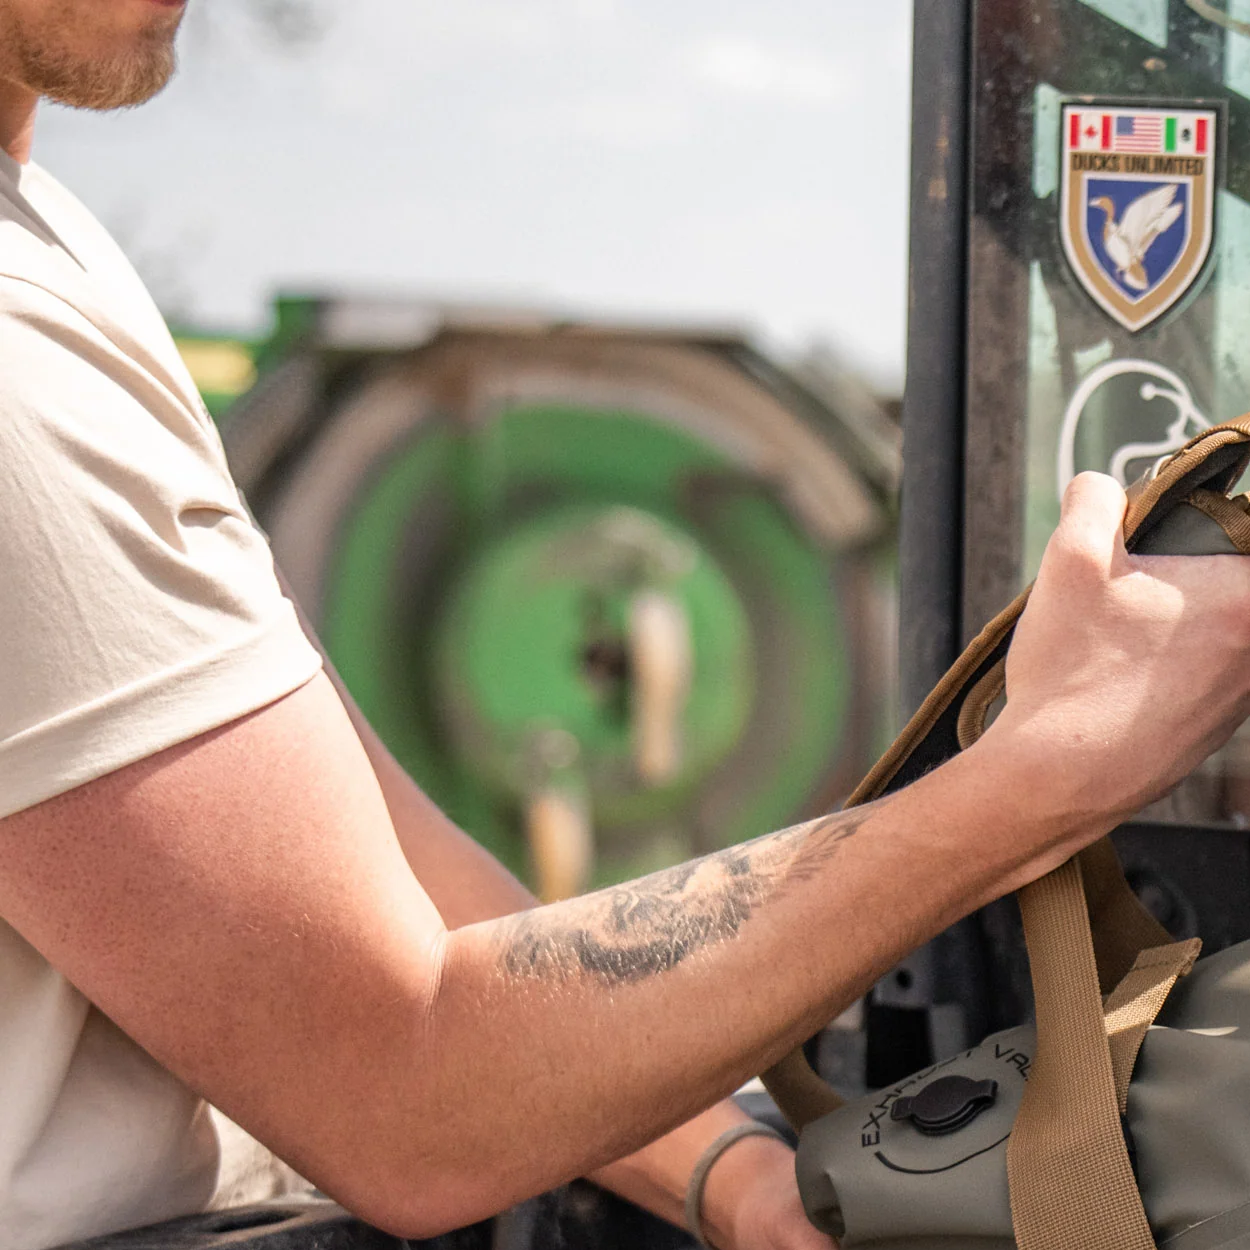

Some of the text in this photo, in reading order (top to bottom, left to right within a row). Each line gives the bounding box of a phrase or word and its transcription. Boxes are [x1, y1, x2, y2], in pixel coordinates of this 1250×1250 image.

[1072, 153, 1204, 176] DUCKS UNLIMITED
[993, 1043, 1032, 1081] VAL
